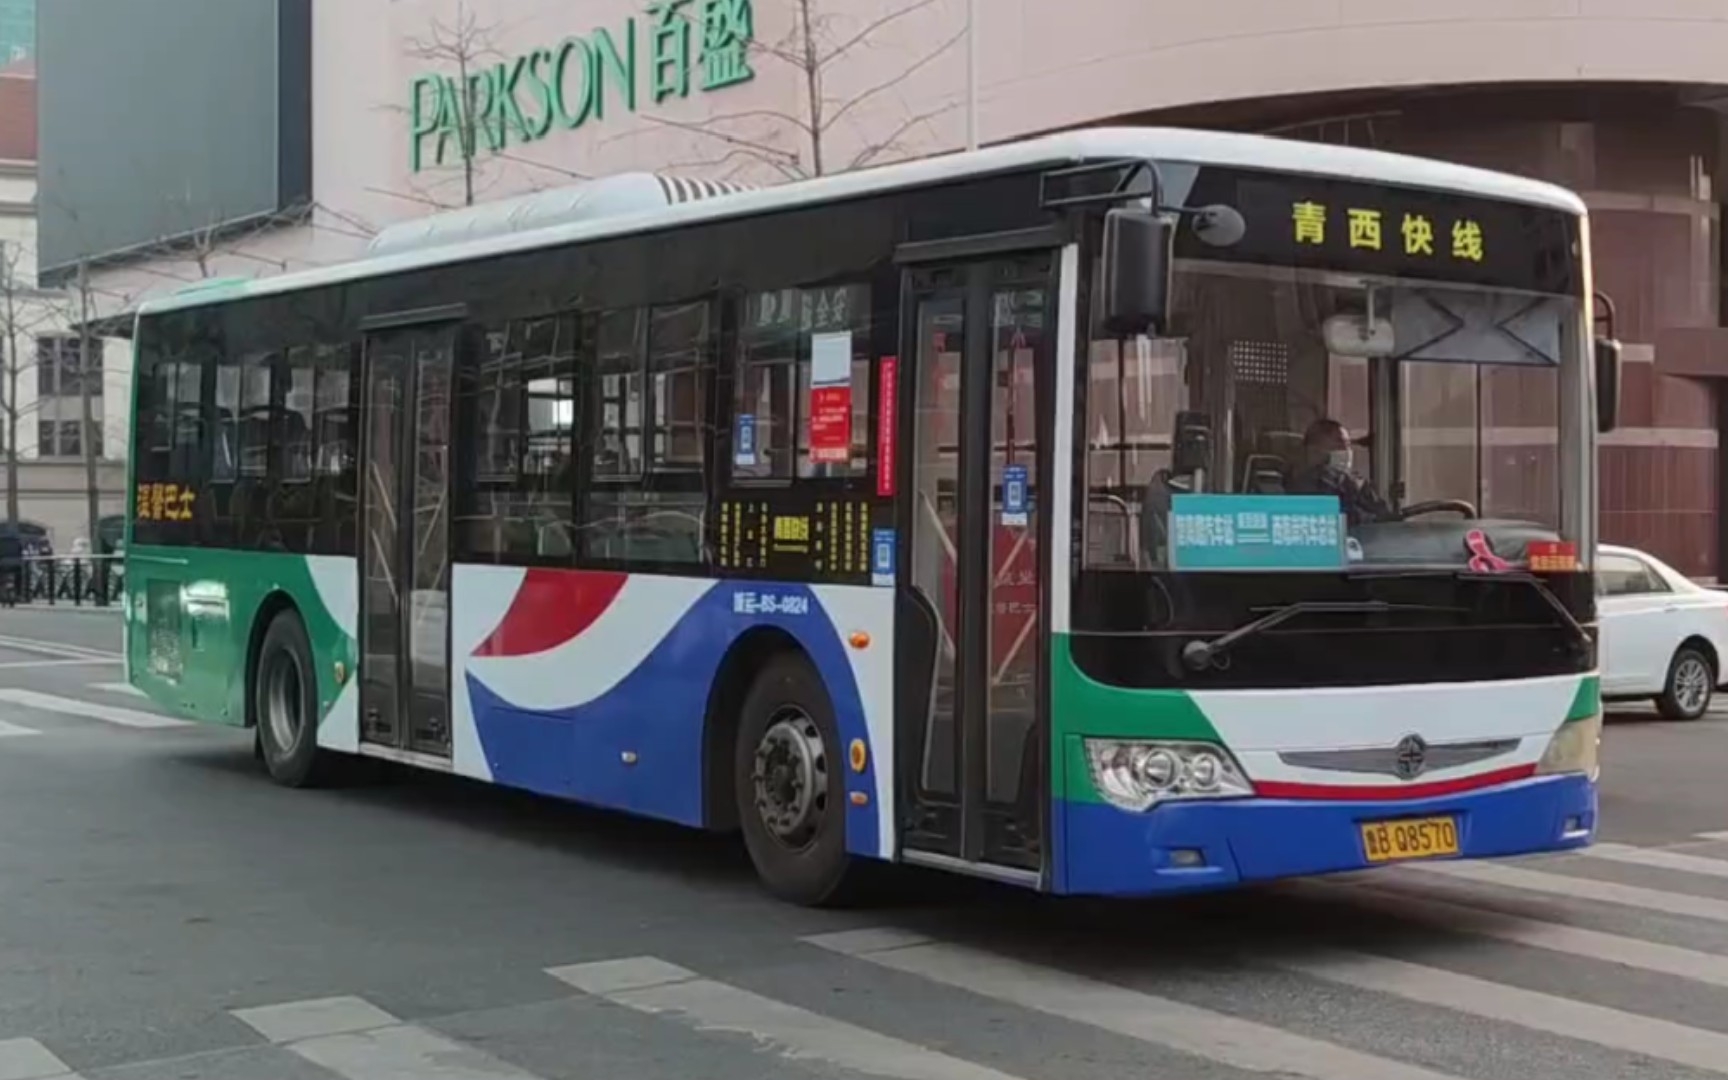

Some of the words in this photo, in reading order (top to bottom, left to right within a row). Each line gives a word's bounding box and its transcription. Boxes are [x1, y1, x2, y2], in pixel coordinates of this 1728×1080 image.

[409, 17, 636, 172] PARKSON
[644, 0, 755, 104] 百盛
[1292, 201, 1483, 261] 青西快线
[1395, 821, 1455, 852] Q8570
